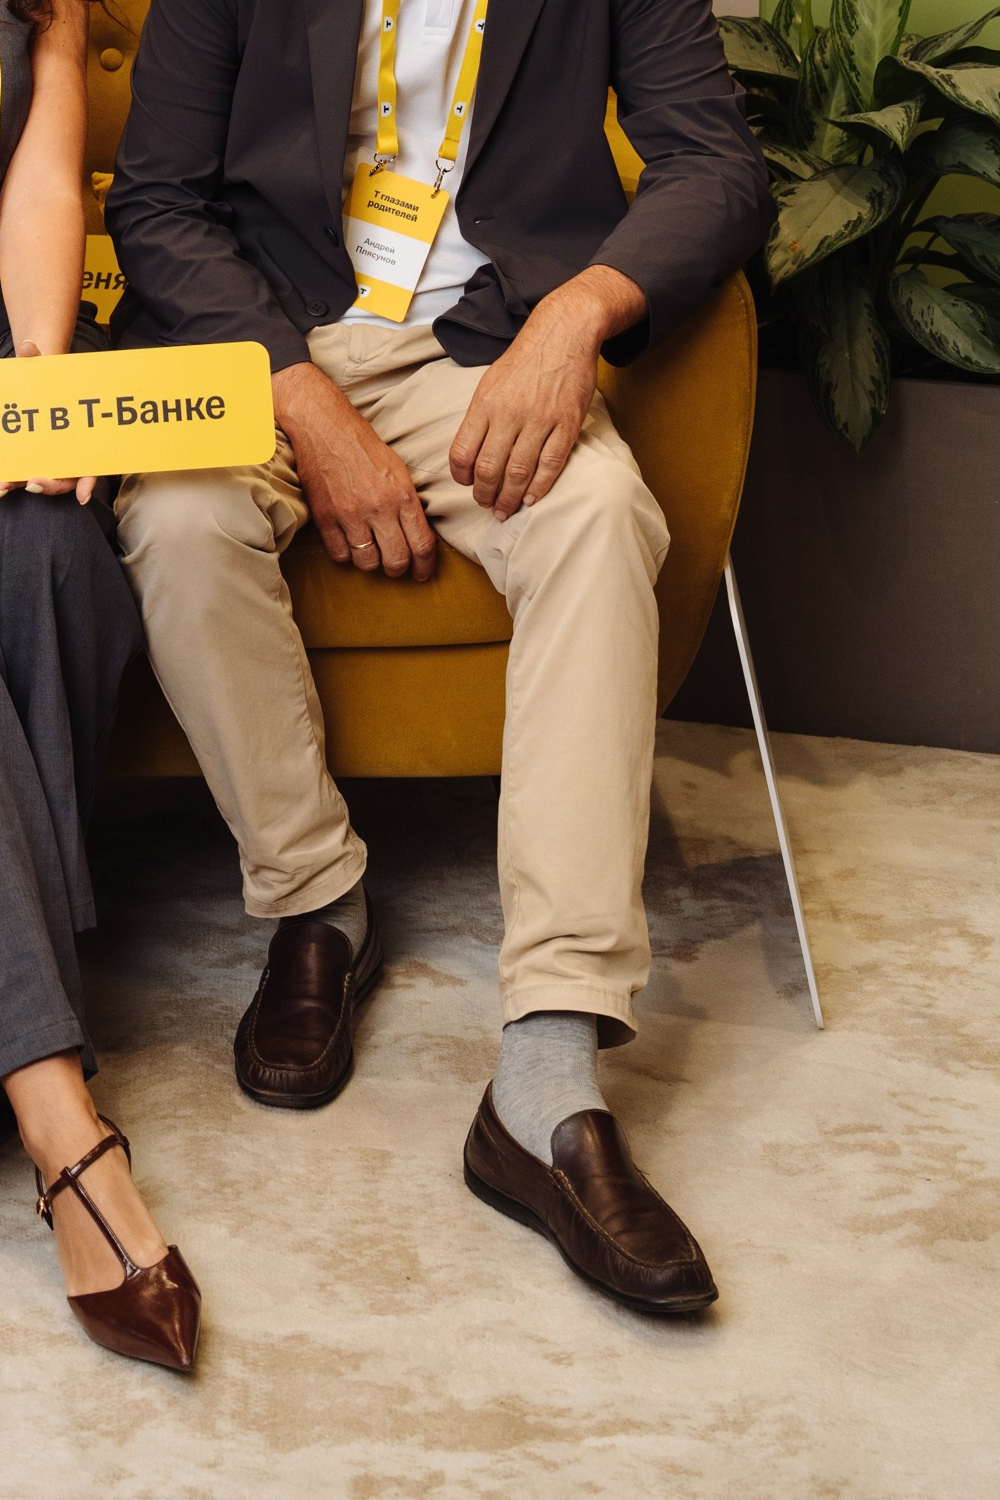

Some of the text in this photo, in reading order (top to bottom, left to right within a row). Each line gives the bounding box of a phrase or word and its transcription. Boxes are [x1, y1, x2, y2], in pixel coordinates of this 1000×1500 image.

[367, 200, 419, 223] родителей
[374, 190, 419, 213] Т глазами
[355, 245, 397, 266] Плясунов
[363, 238, 396, 255] Андрей
[50, 407, 70, 431] в
[78, 395, 226, 428] Т-Банке
